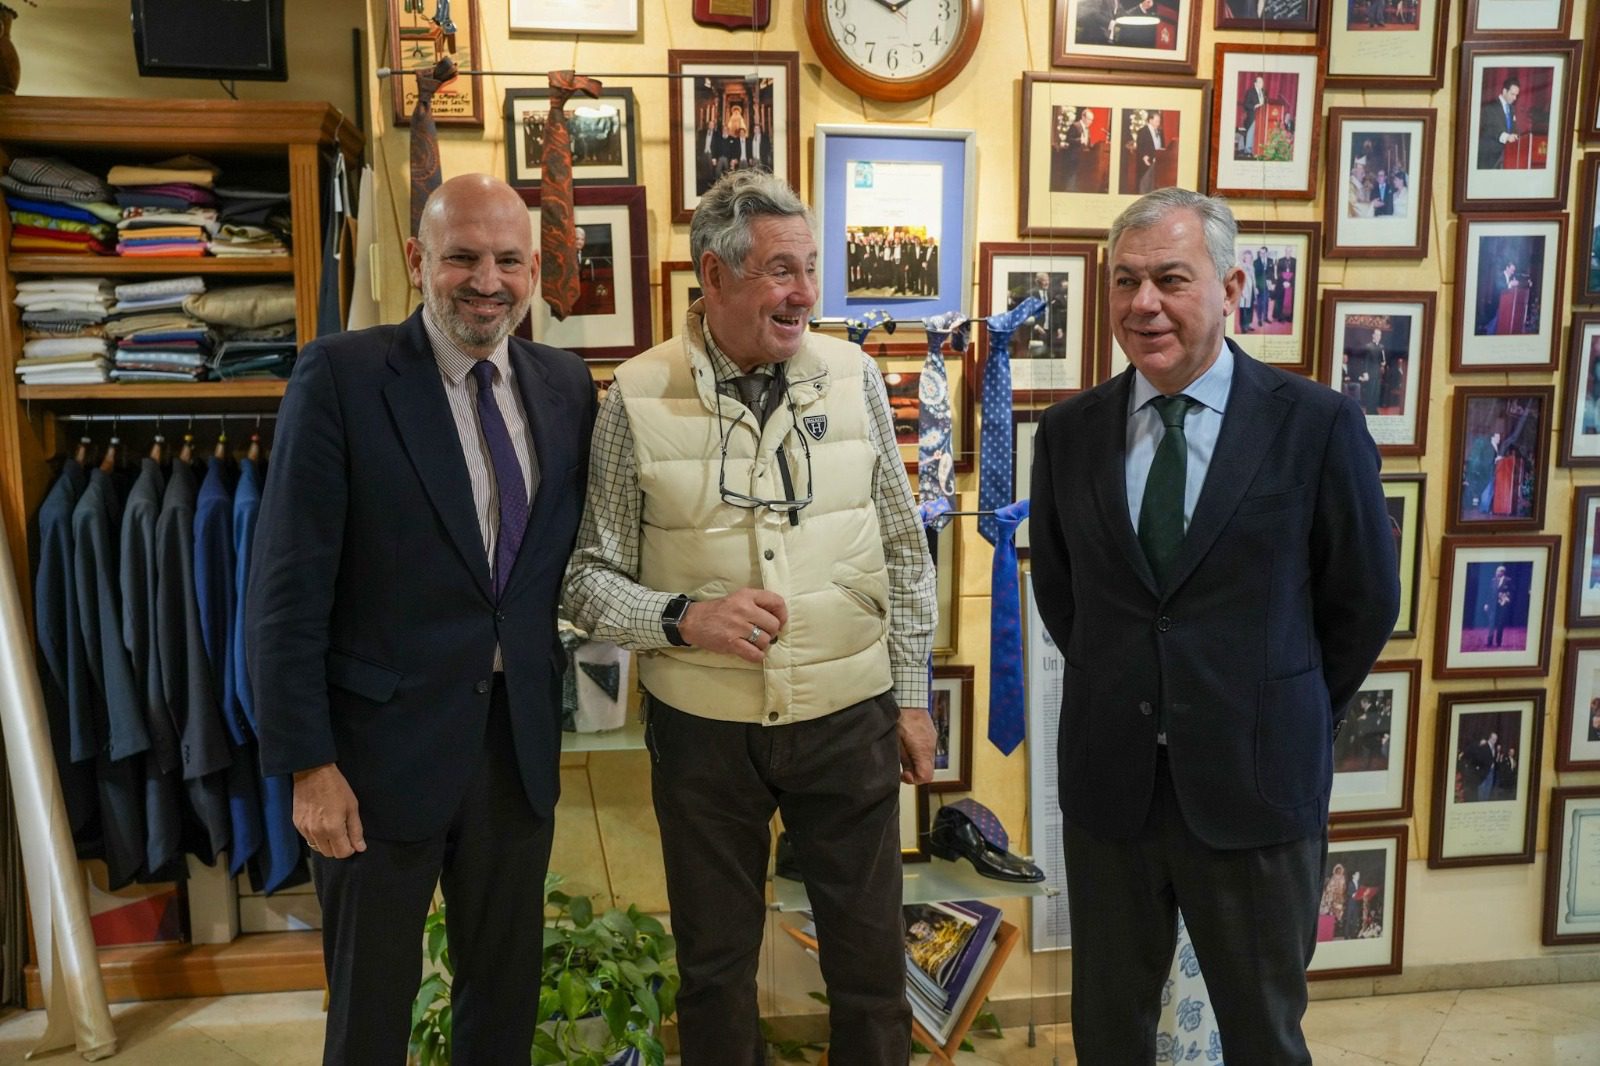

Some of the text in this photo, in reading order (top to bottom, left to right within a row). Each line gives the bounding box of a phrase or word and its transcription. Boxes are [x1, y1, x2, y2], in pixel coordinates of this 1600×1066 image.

[834, 0, 847, 19] 9
[938, 0, 950, 21] 3
[843, 23, 857, 45] 8
[929, 26, 942, 46] 4
[864, 42, 876, 64] 7
[886, 49, 899, 71] 6
[911, 43, 924, 64] 5
[811, 423, 823, 433] H
